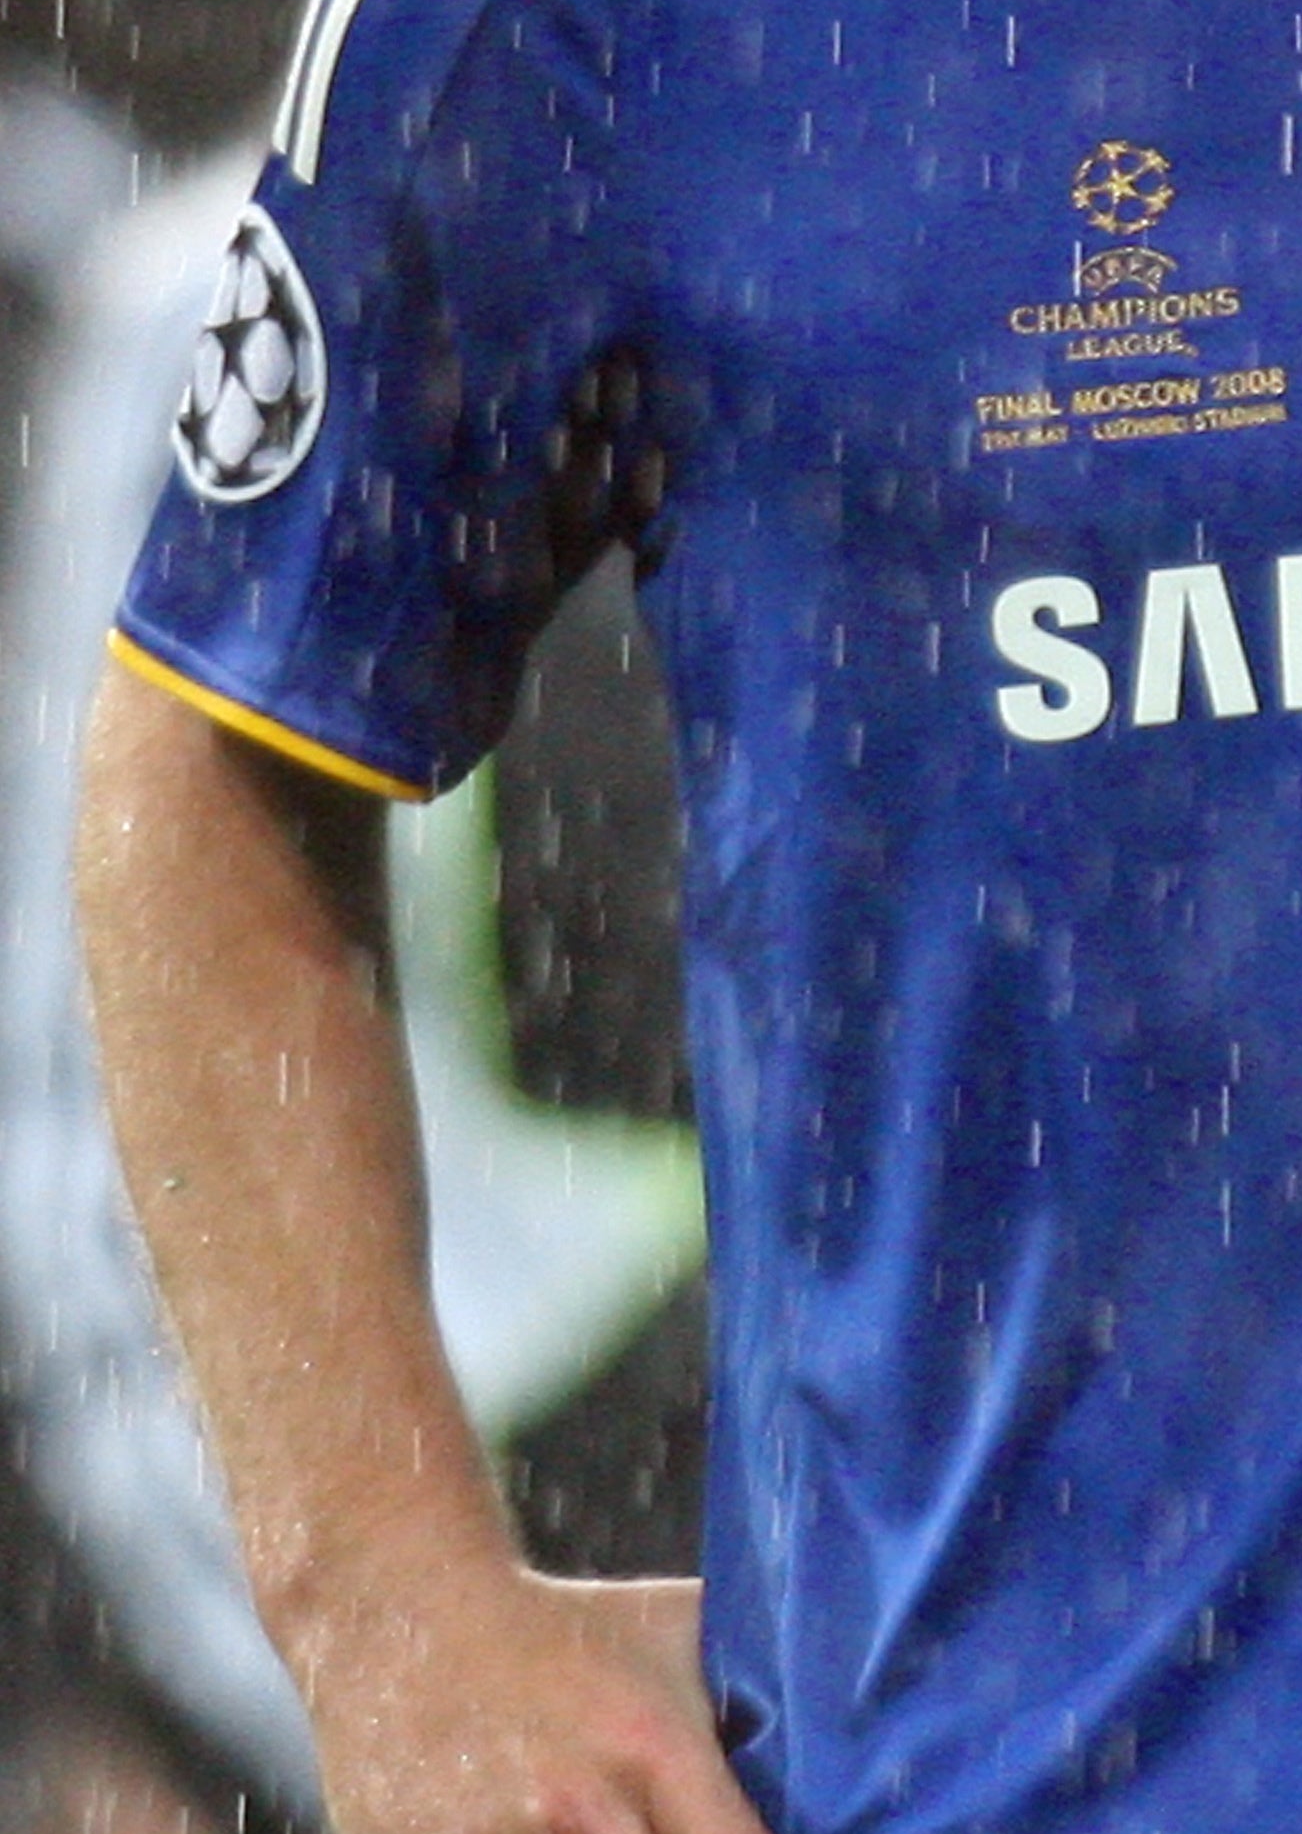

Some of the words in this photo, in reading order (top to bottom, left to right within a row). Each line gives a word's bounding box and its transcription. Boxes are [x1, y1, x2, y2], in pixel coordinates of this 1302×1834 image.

[1009, 286, 1242, 335] CHAMPIONS
[1066, 329, 1188, 361] LEAGUE
[975, 391, 1064, 425] FINAL
[1072, 378, 1200, 415] MOSCOW
[1210, 367, 1287, 401] 2008
